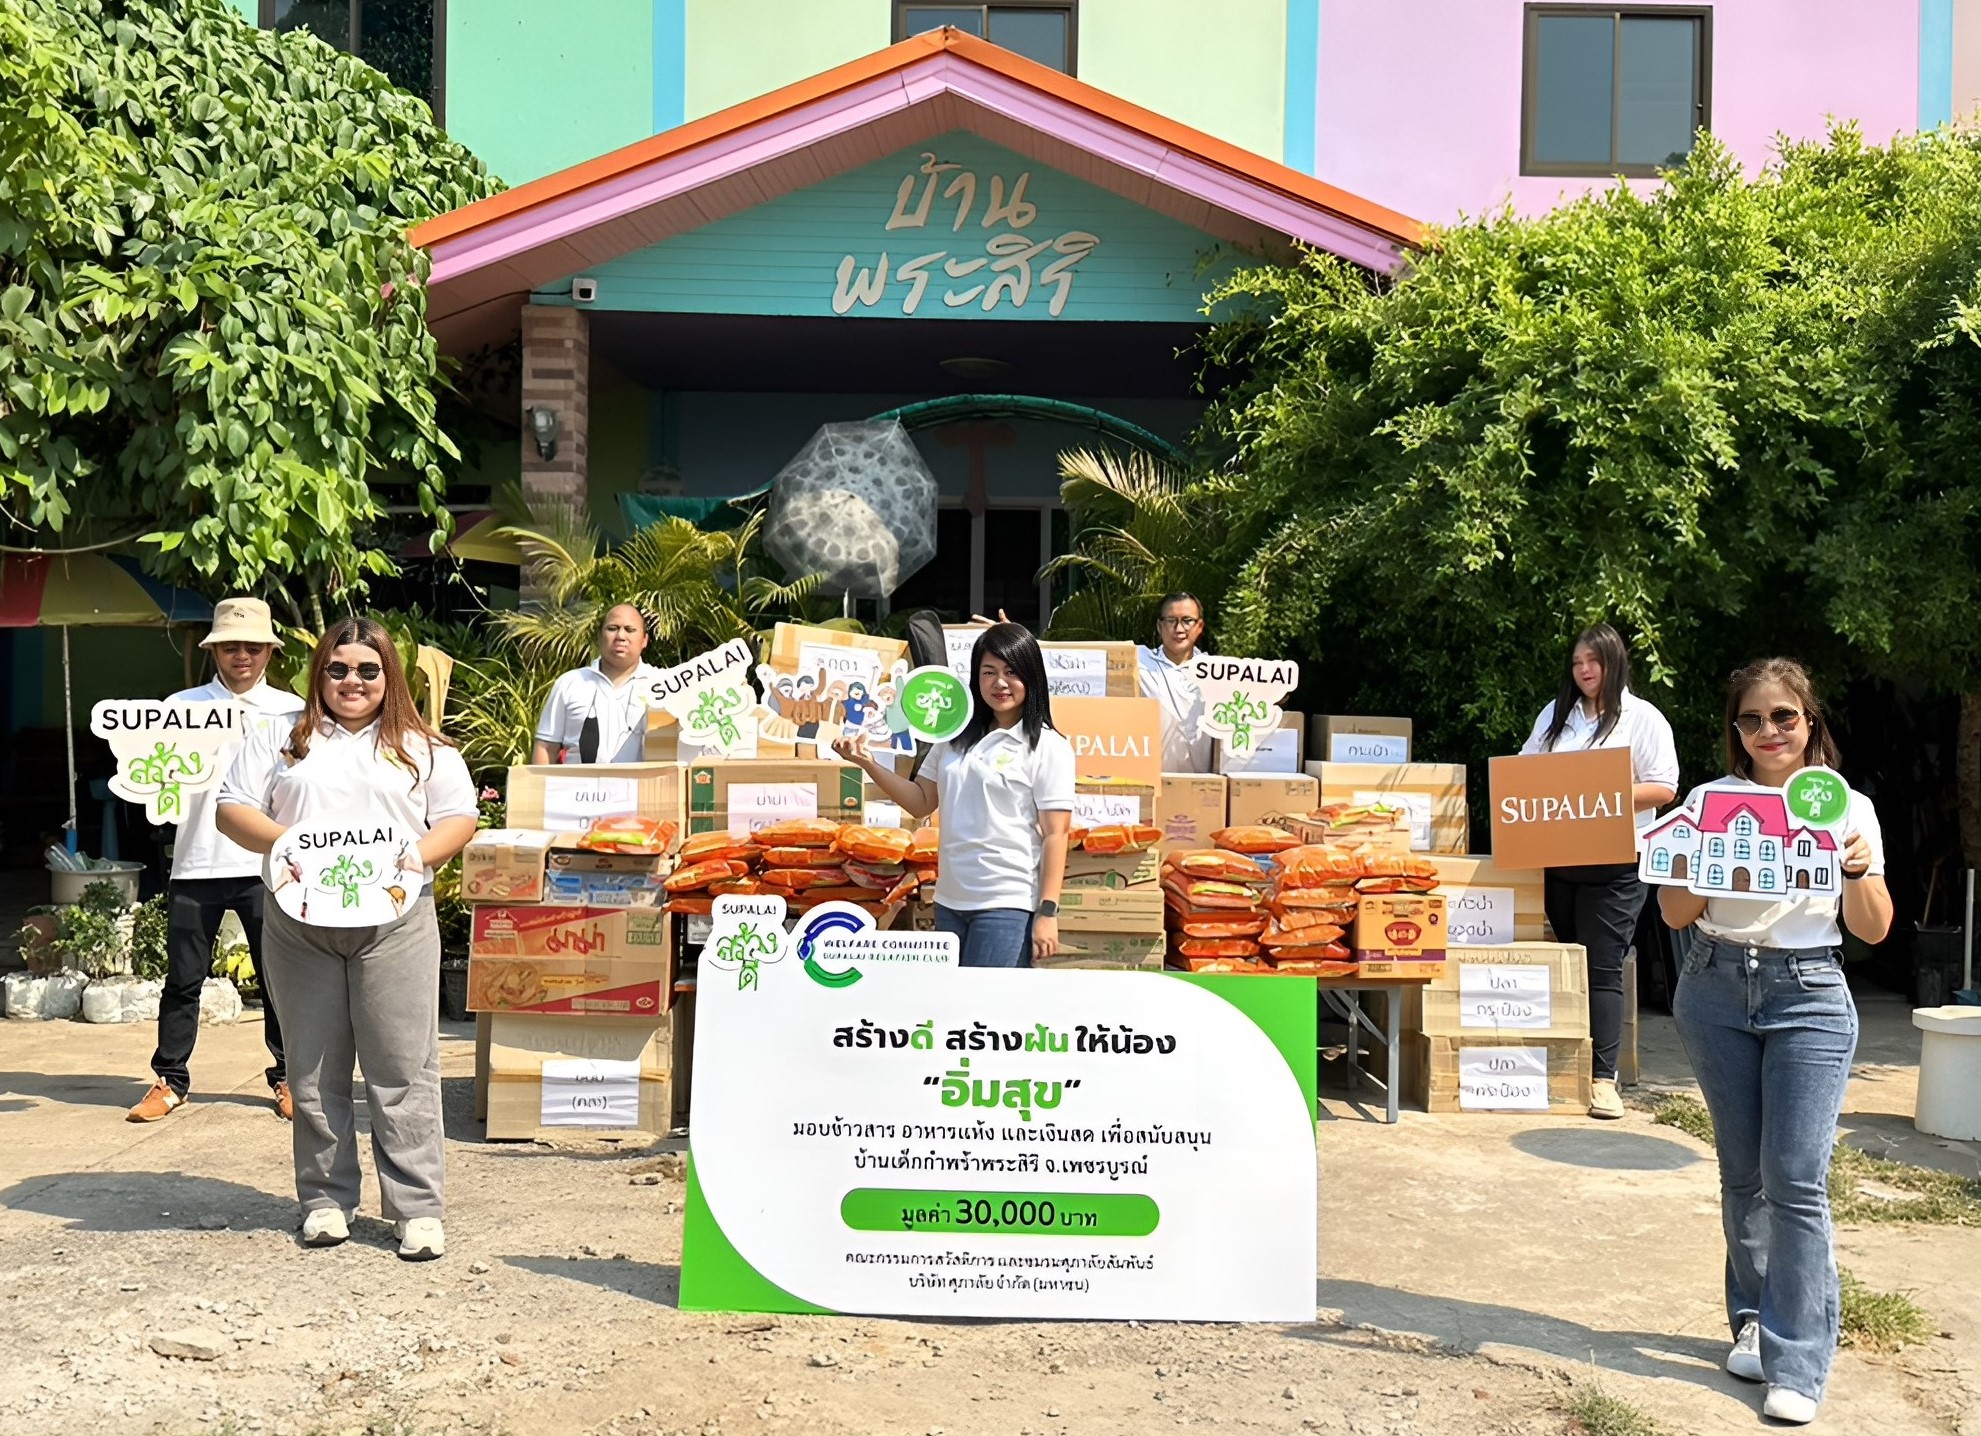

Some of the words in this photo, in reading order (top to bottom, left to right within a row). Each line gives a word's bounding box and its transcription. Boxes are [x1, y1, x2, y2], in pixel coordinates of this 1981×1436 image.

[885, 152, 1037, 232] บ้าน
[832, 231, 1100, 317] พระสิริ
[650, 643, 747, 701] SUPALAI
[1195, 662, 1292, 685] SUPALAI
[102, 708, 233, 731] SUPALAI
[1500, 791, 1624, 825] SUPALAI
[298, 827, 394, 850] SUPALAI
[721, 903, 777, 915] SUPALAI
[833, 1018, 934, 1050] สร้างดี
[945, 1021, 1069, 1053] สร้างฝัน
[1074, 1023, 1177, 1055] ให้น้อง
[901, 1202, 951, 1231] มูลค่า
[955, 1199, 1055, 1227] 30,000
[1061, 1211, 1098, 1227] บาท
